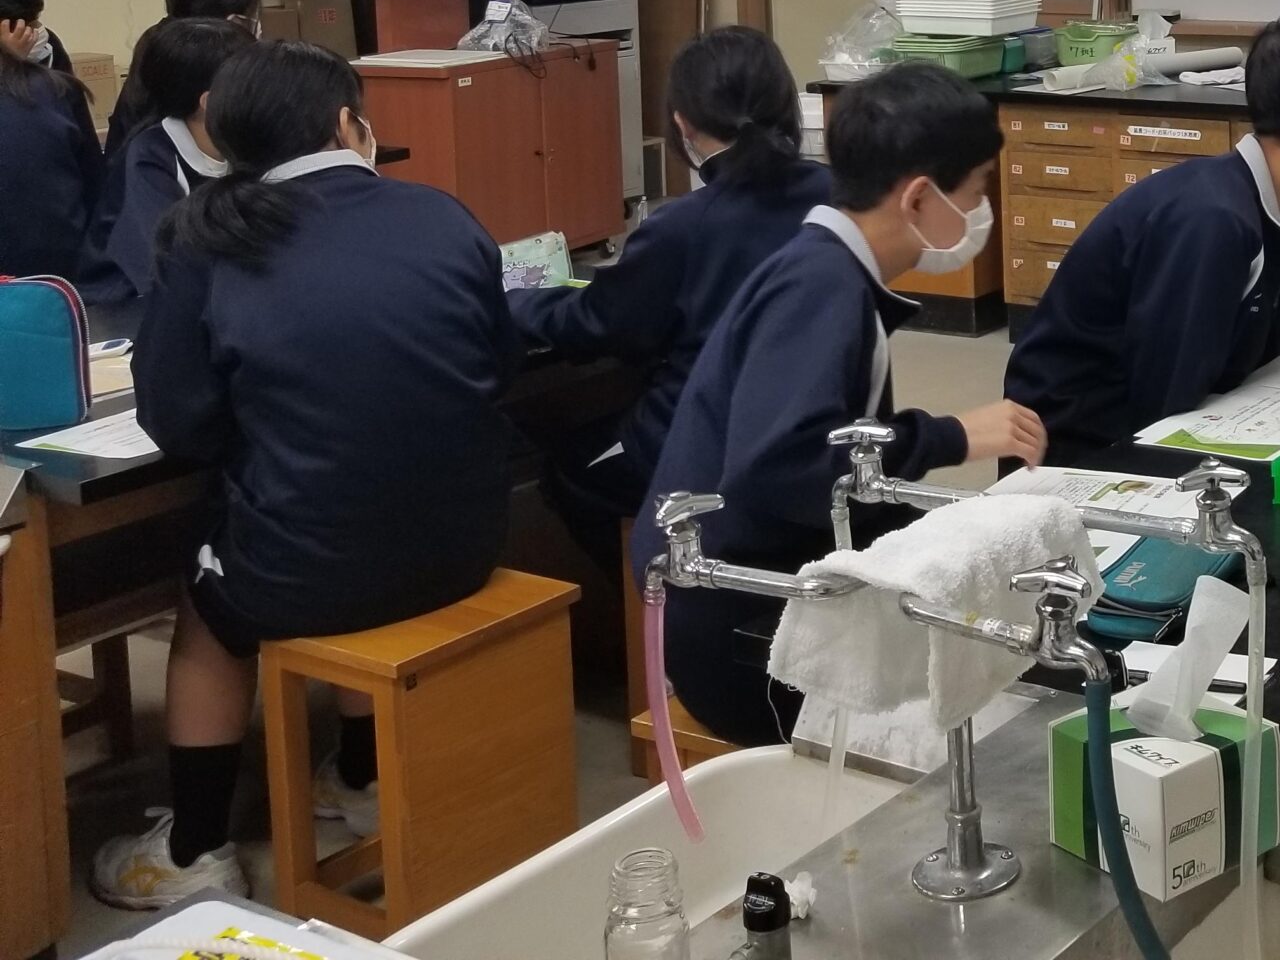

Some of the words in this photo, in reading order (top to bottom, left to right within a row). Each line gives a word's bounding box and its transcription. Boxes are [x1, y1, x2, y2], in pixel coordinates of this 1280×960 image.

[1069, 46, 1095, 58] 7班
[1121, 136, 1129, 144] 71
[1129, 744, 1180, 767] キムワイプ
[1119, 814, 1141, 839] 0th
[1172, 858, 1206, 890] 50th
